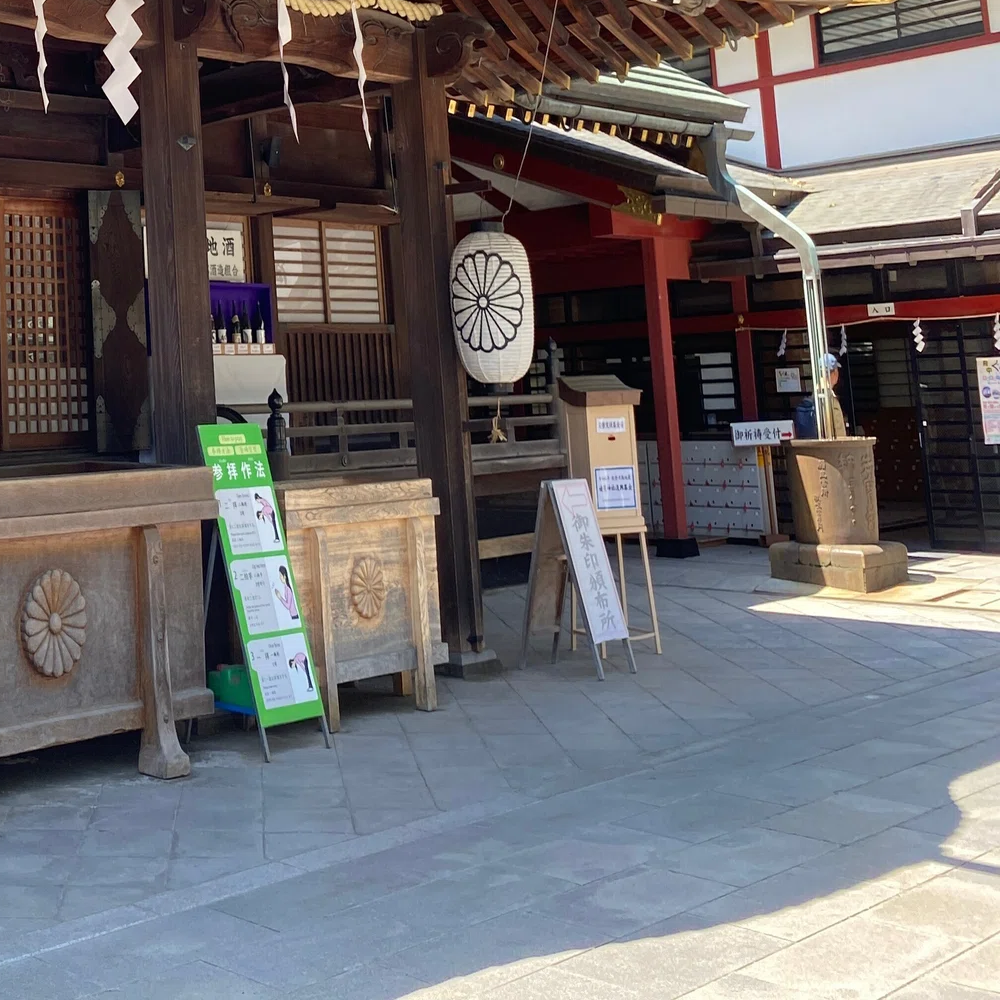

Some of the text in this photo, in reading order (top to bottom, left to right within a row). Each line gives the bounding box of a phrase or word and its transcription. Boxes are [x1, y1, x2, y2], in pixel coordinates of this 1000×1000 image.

[872, 306, 891, 314] 入口
[212, 460, 266, 481] 参拝作法
[572, 514, 617, 631] 御朱印頒布所
